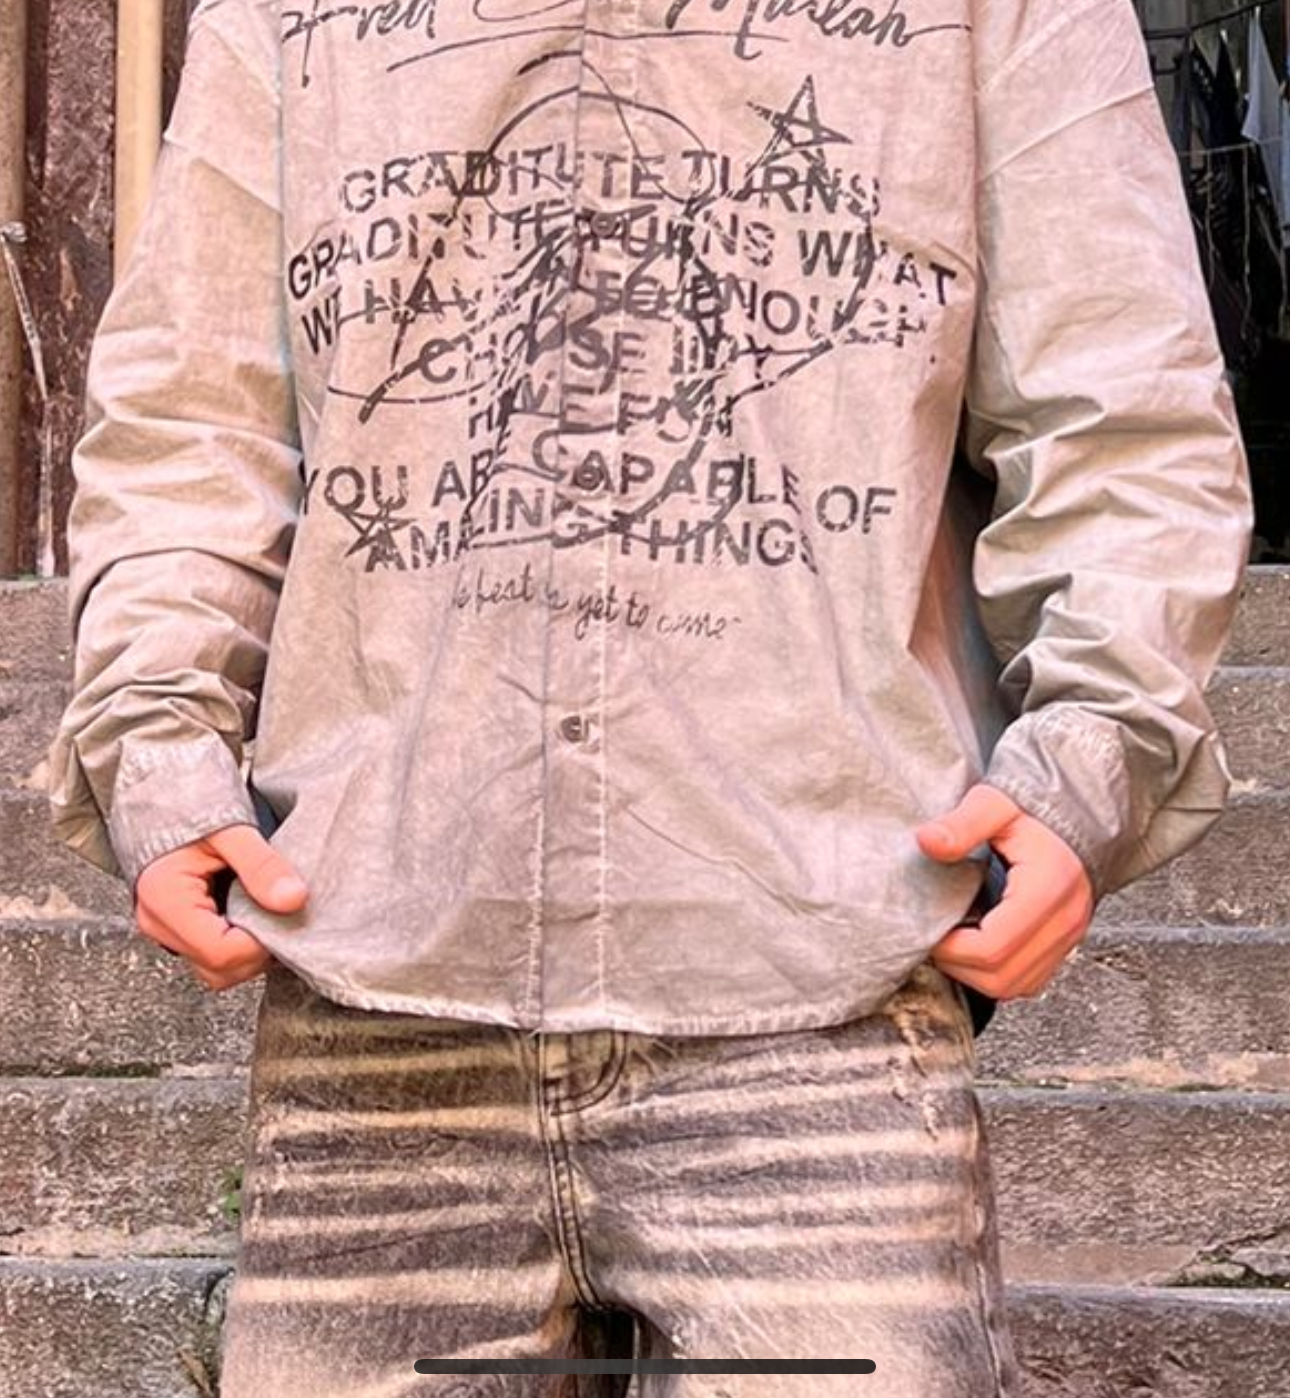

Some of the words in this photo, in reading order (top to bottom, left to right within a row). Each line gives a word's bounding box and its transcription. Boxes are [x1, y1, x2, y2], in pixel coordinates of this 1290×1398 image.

[298, 458, 408, 516] YOU
[531, 427, 801, 505] CAPABLE
[815, 484, 897, 535] OF
